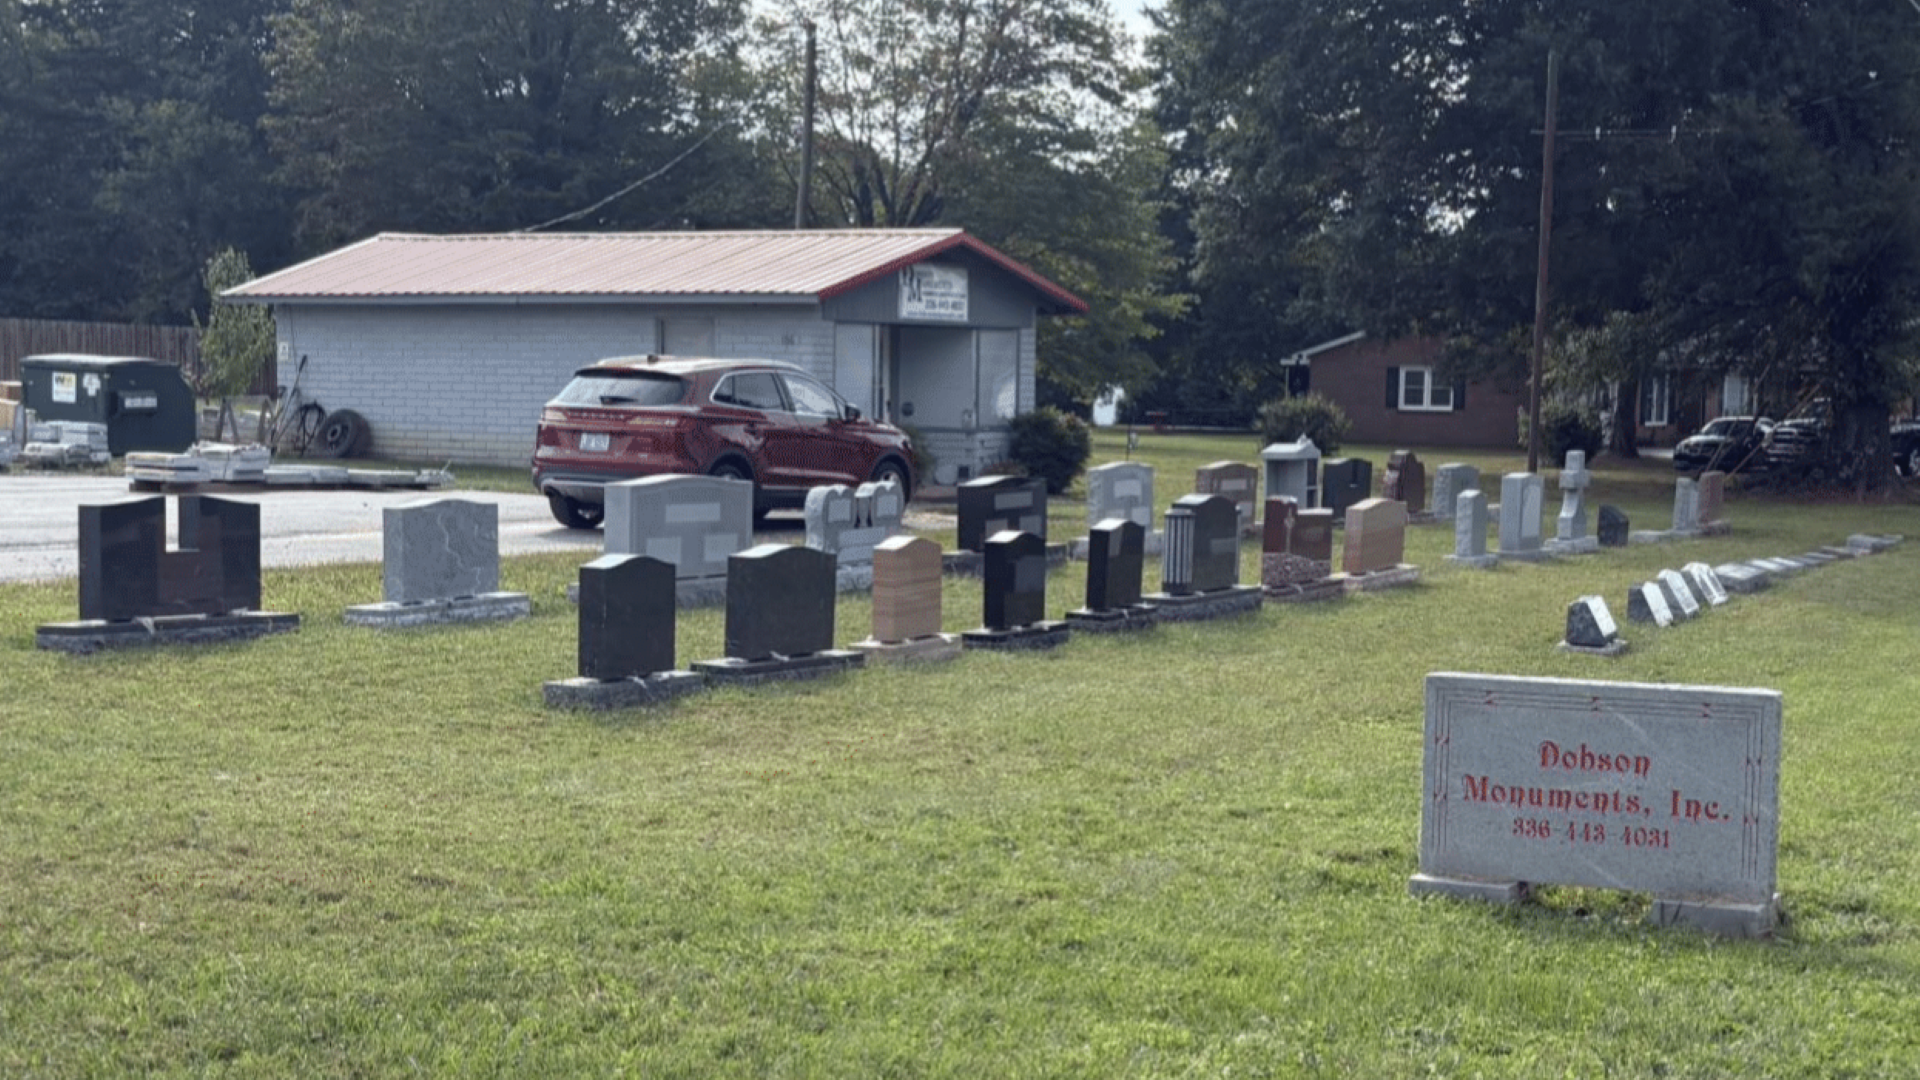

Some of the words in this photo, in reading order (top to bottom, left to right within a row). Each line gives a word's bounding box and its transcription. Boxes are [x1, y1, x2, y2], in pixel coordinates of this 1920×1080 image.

[1539, 740, 1651, 778] Dobson
[1463, 774, 1652, 817] Monuments,
[1670, 789, 1731, 824] Inc.
